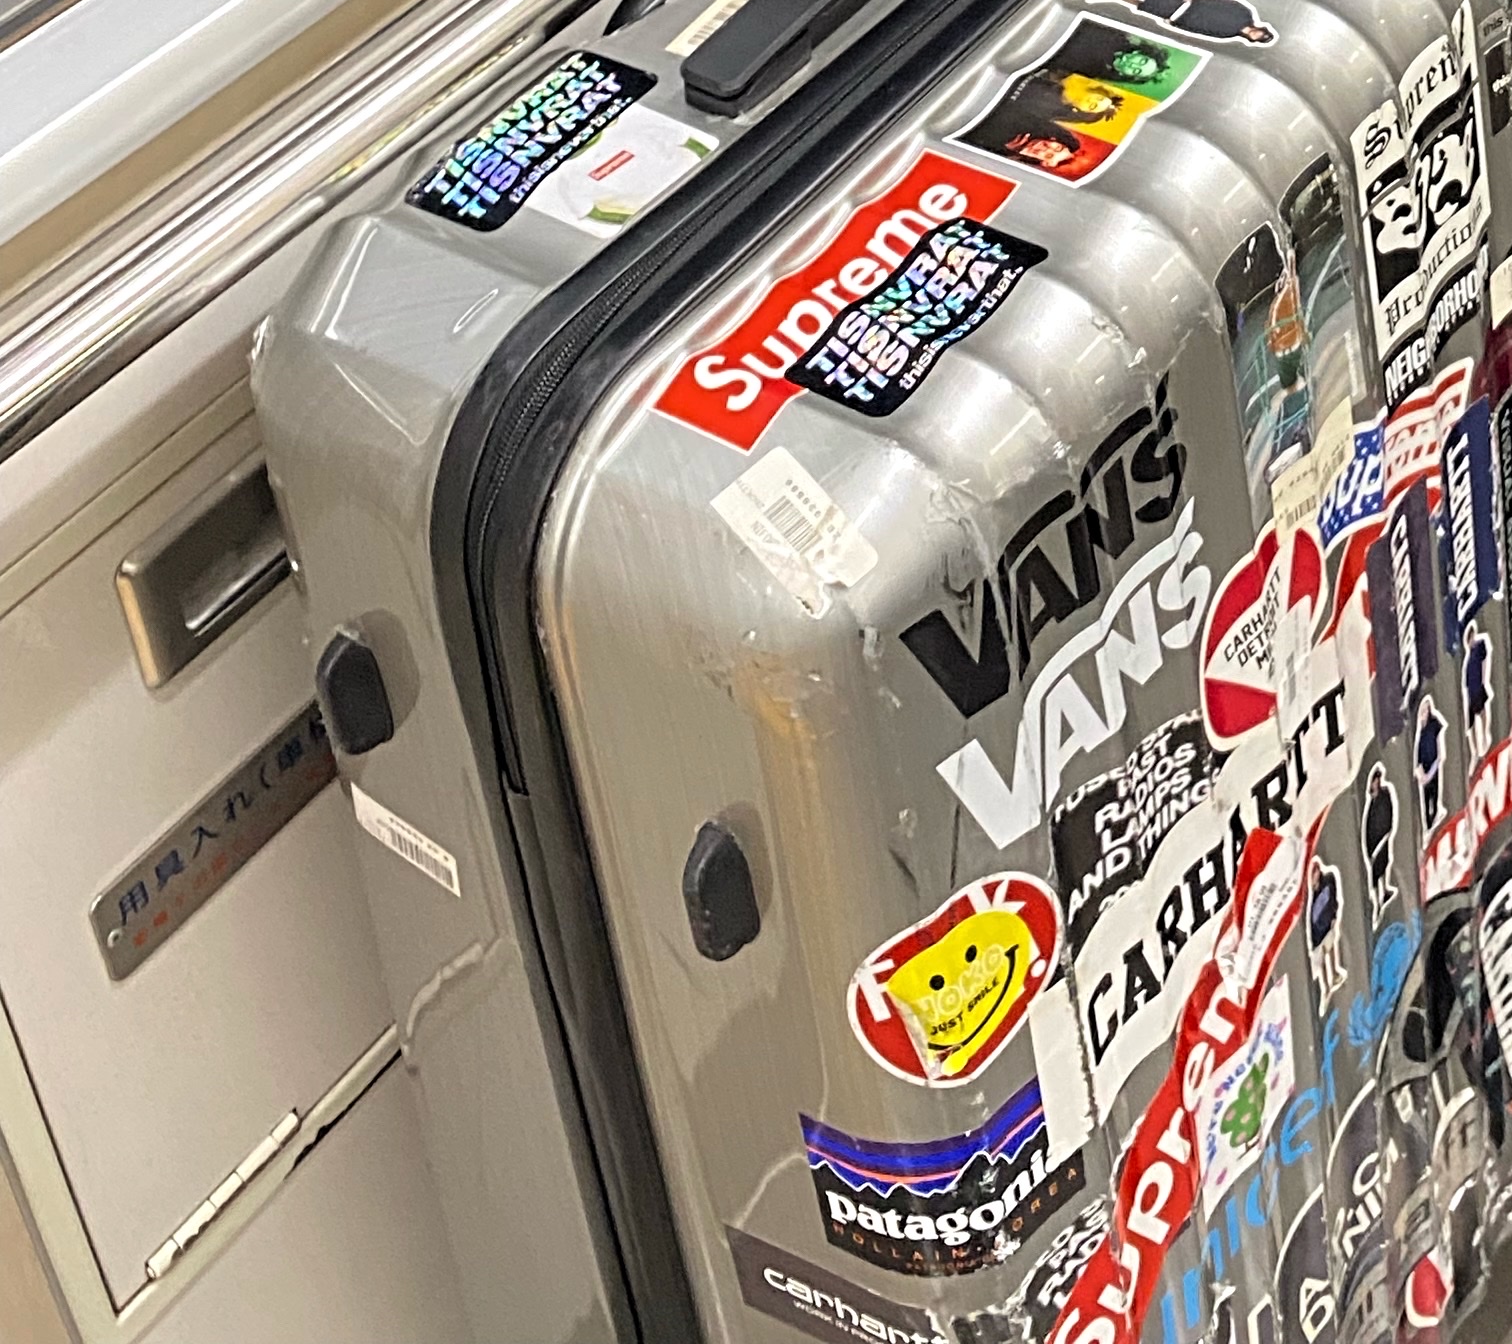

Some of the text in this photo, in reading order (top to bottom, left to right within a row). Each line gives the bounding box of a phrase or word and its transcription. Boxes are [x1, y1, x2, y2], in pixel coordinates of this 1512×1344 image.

[692, 182, 969, 411] Supreme
[900, 372, 1187, 719] VANS
[936, 496, 1212, 850] VANS
[1067, 846, 1134, 927] AND
